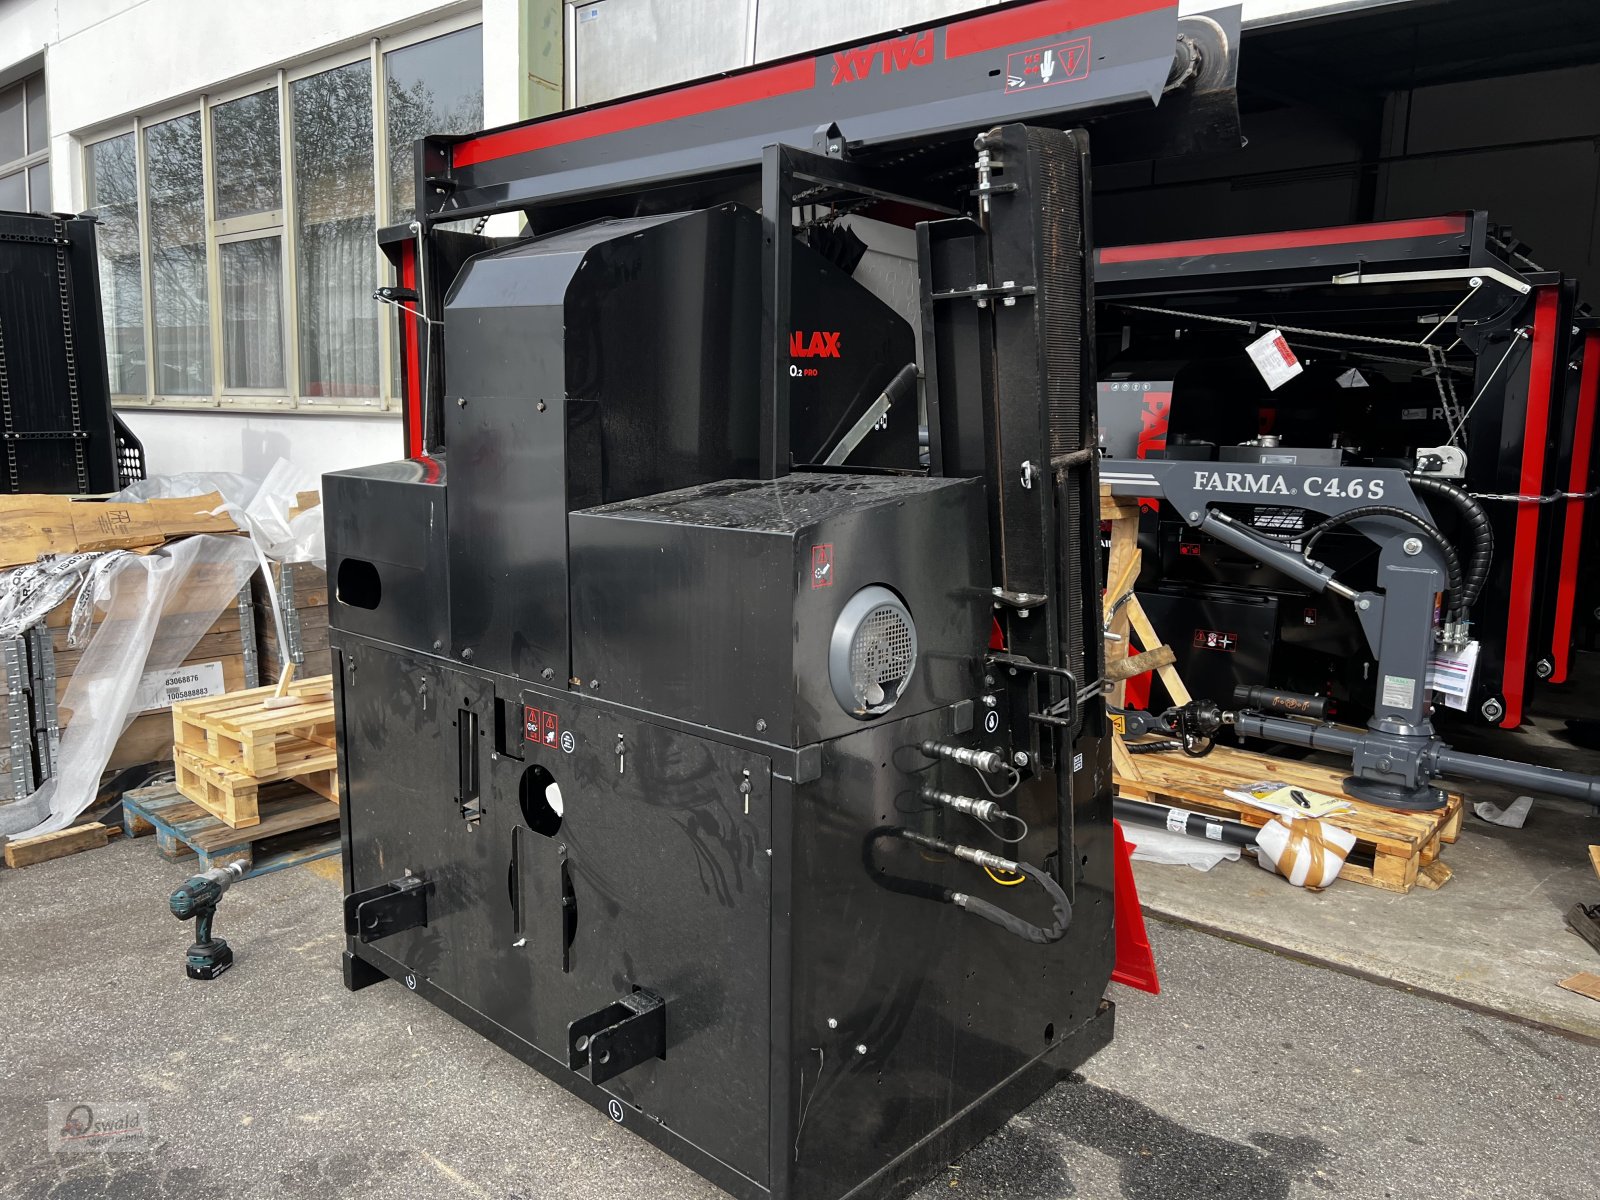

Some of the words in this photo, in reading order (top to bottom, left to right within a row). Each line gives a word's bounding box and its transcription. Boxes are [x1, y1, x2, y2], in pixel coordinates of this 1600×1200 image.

[831, 29, 935, 87] PALAX
[803, 369, 818, 377] PRO
[1193, 471, 1291, 495] FARMA
